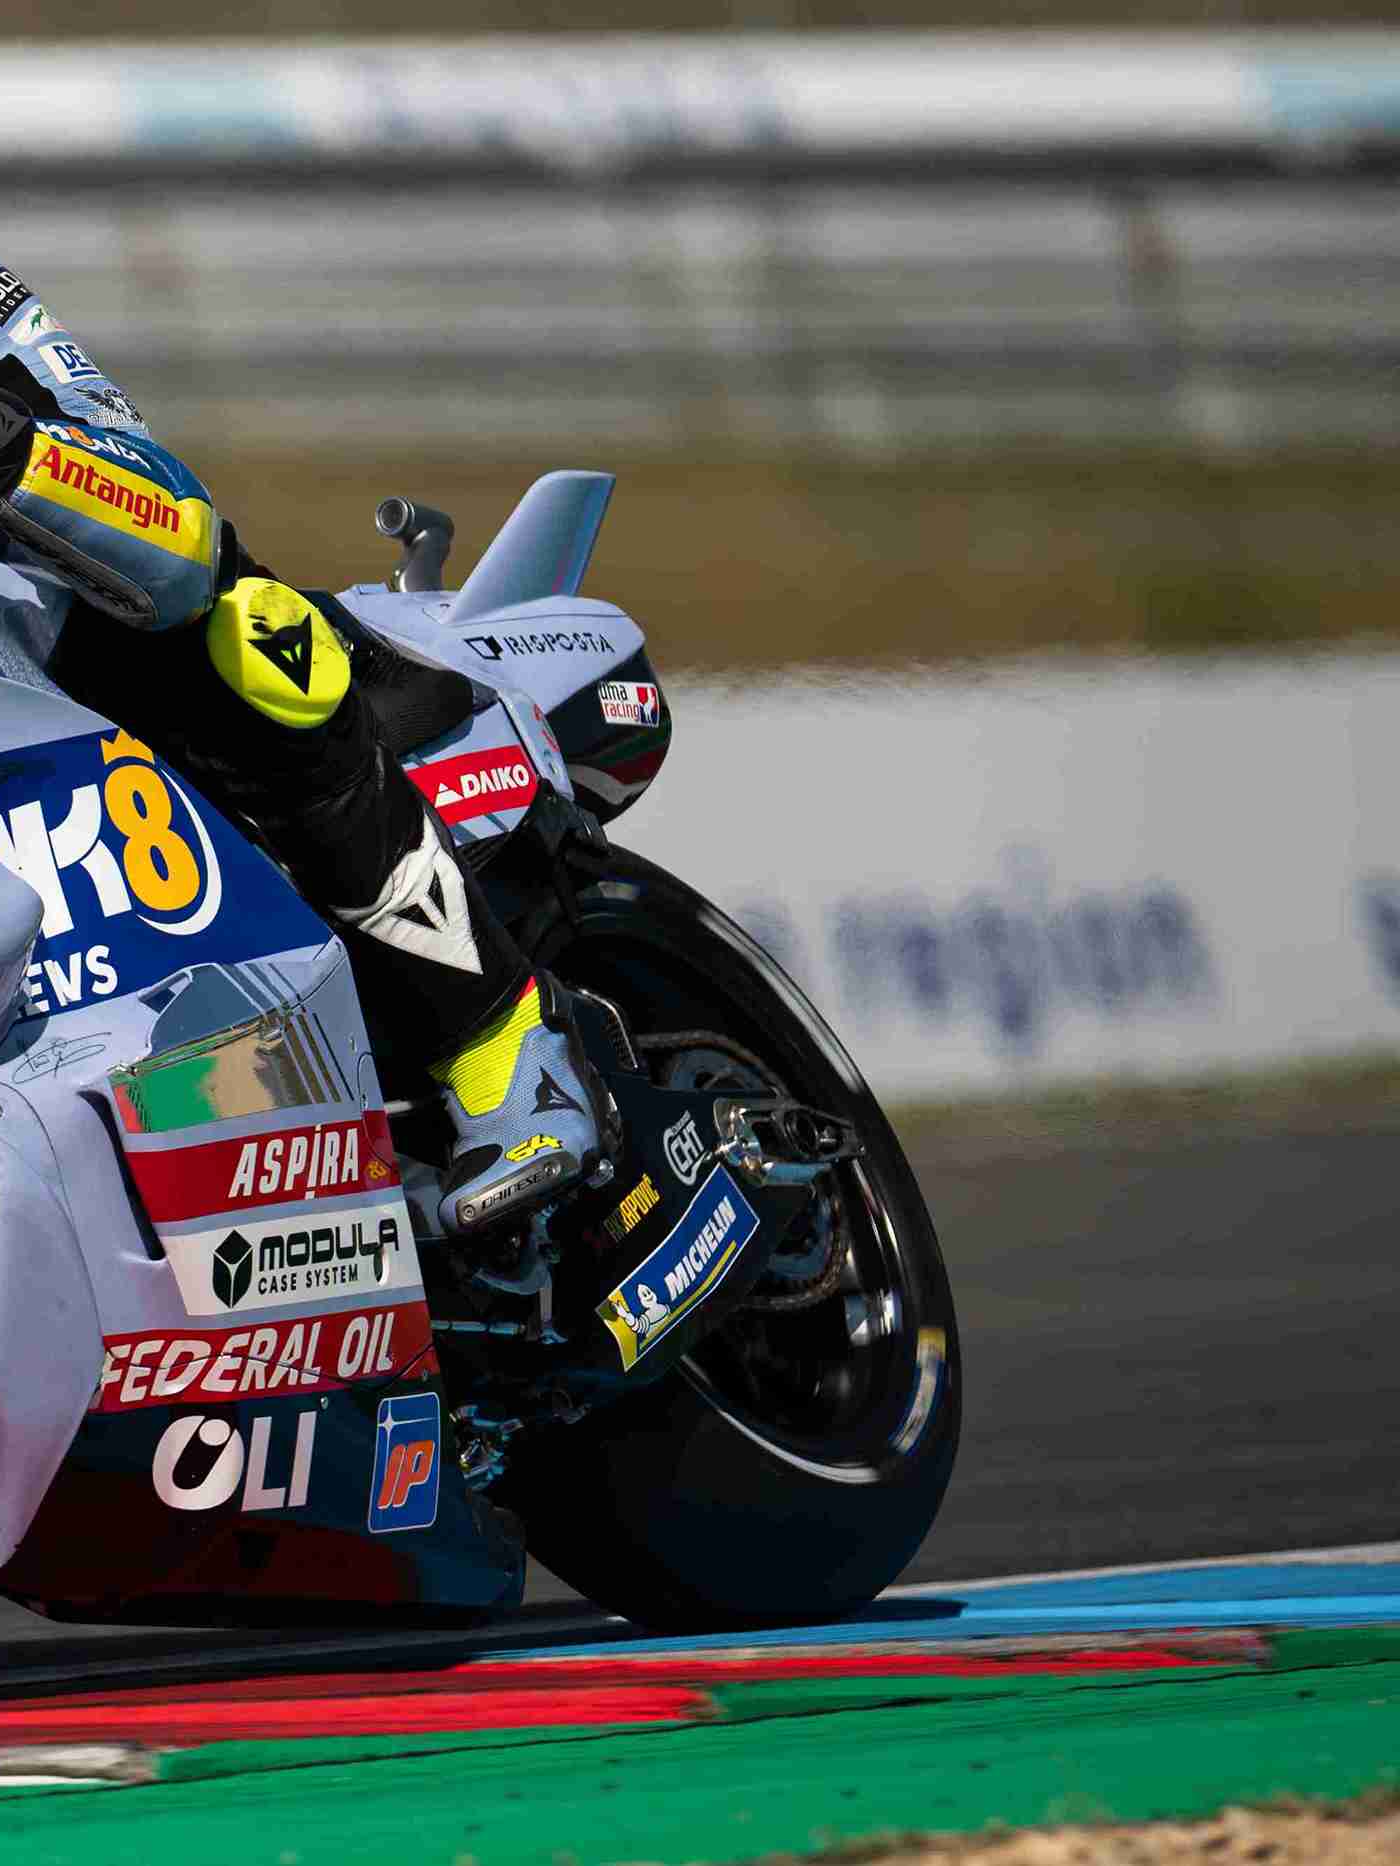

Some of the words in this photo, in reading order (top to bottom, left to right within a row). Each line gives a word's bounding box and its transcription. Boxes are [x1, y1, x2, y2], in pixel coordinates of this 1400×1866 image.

[32, 445, 181, 534] Antangin
[503, 632, 616, 656] RISPOSTA
[603, 701, 641, 722] racing
[460, 764, 530, 799] DAIKO
[228, 1125, 360, 1200] ASPIRA
[258, 1217, 399, 1273] MODULA
[664, 1196, 737, 1303] MICHELIN
[258, 1274, 297, 1296] CASE
[306, 1266, 359, 1290] SYSTEM
[101, 1320, 322, 1402] FEDERAL
[337, 1311, 396, 1380] OIL
[378, 1440, 436, 1510] IP
